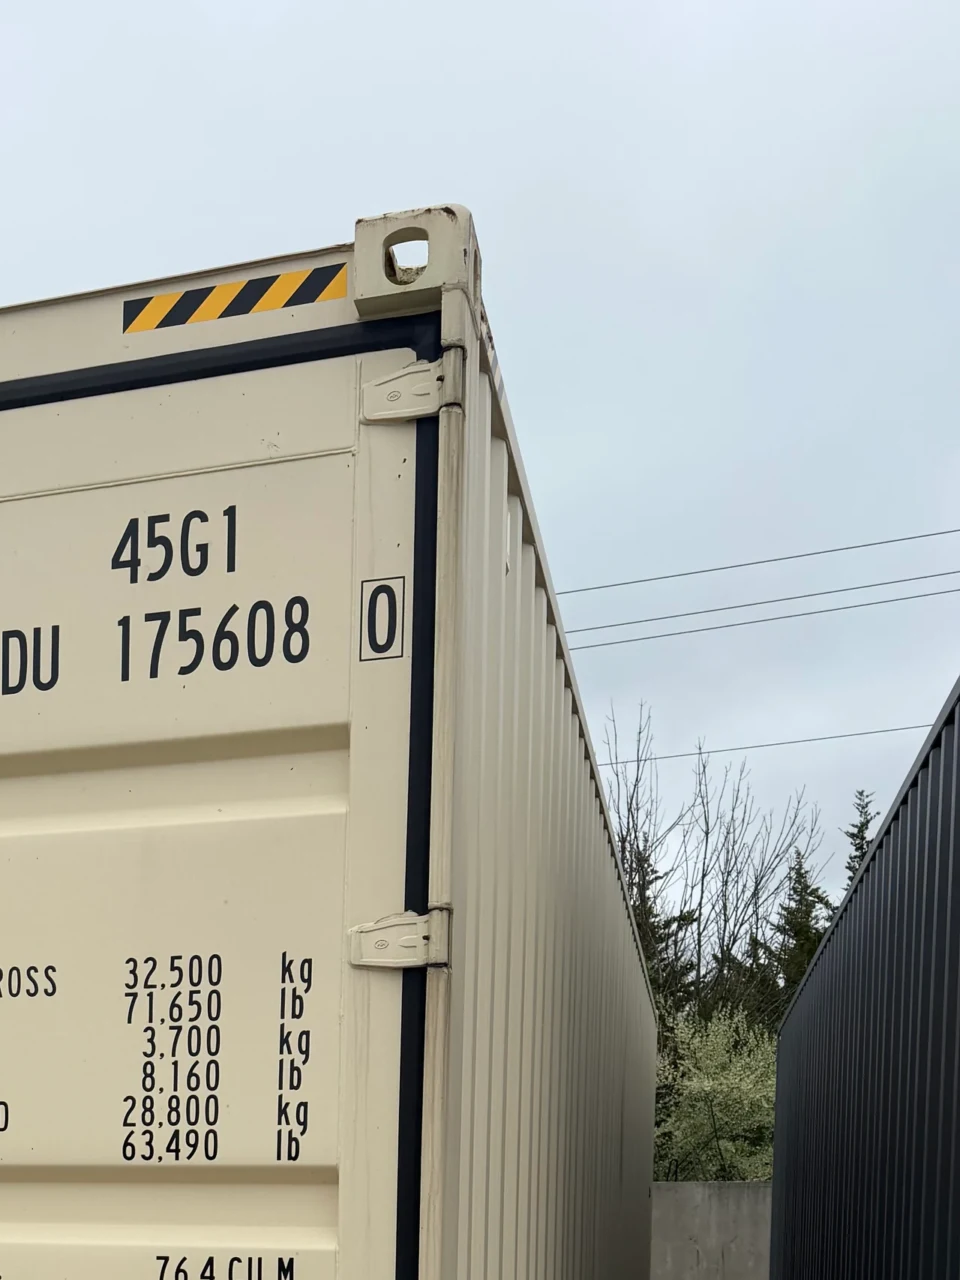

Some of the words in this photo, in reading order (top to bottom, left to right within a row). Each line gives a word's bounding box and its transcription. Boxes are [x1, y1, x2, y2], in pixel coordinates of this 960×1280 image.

[111, 504, 237, 584] 45G1
[117, 595, 310, 682] 175608
[367, 584, 397, 654] 0
[124, 953, 223, 991] 32,500
[281, 951, 313, 994] kg
[124, 989, 222, 1025] 71,650
[280, 986, 305, 1020] lb
[142, 1024, 221, 1060] 3,700
[279, 1022, 311, 1066] kg
[141, 1059, 220, 1094] 8,160
[278, 1058, 303, 1091] lb
[122, 1094, 219, 1129] 28,800
[277, 1093, 309, 1137] kg
[122, 1128, 218, 1163] 63,490
[276, 1128, 301, 1162] lb
